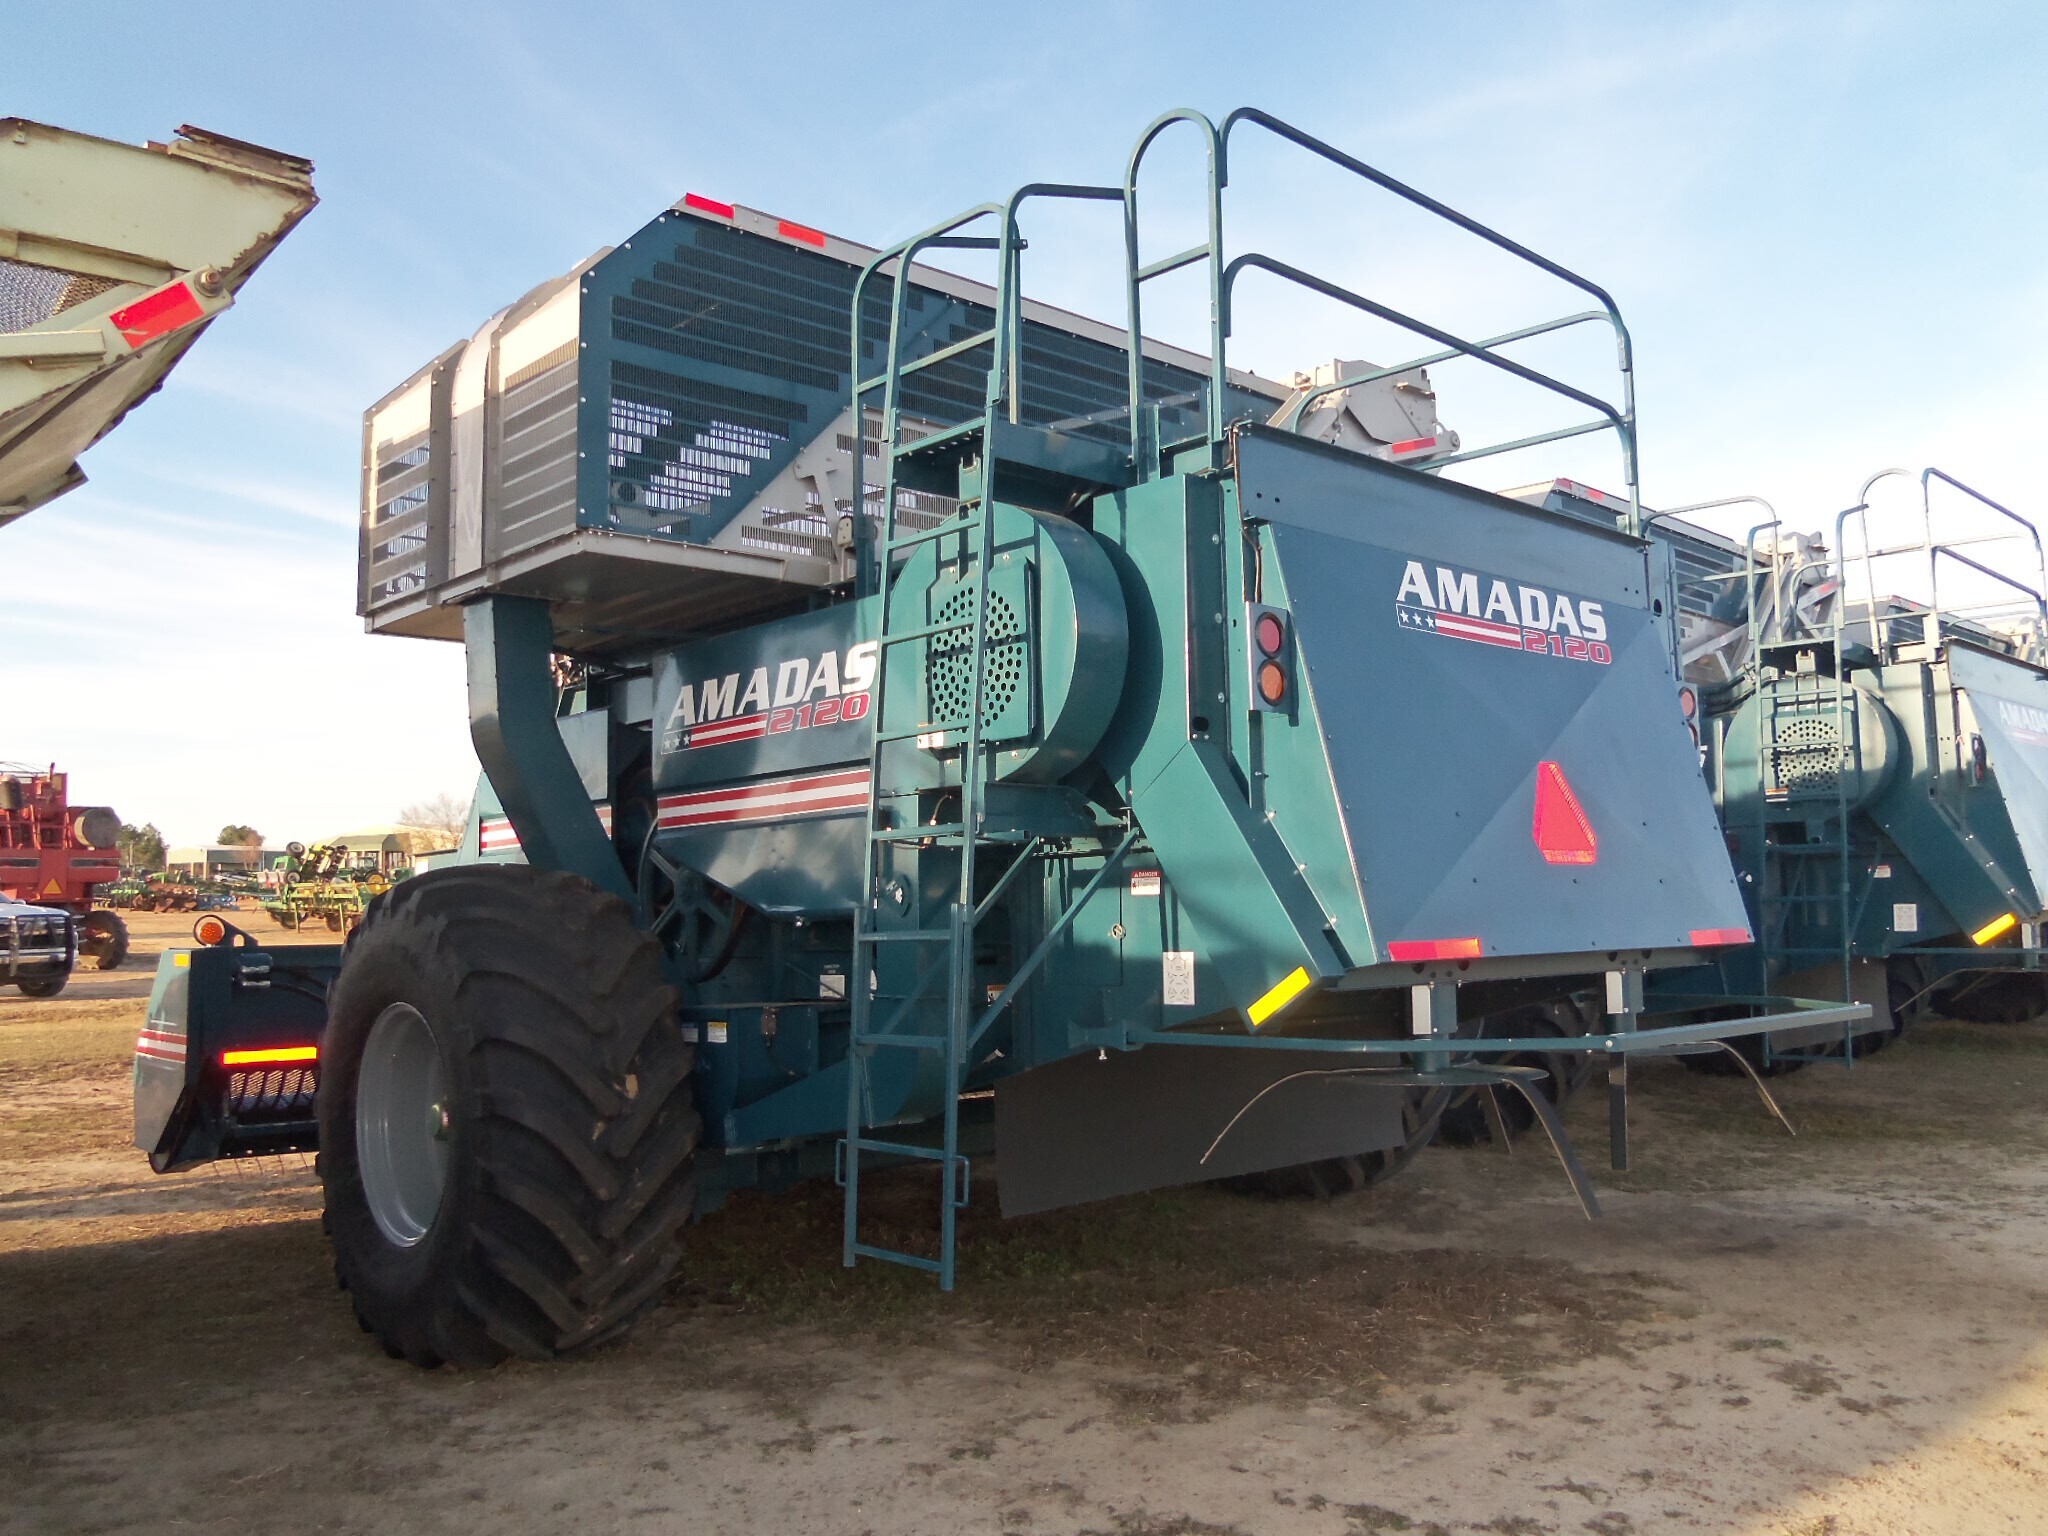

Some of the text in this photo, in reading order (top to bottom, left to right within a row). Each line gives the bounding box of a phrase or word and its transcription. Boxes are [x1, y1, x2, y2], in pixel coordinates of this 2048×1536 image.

[1396, 560, 1607, 641] AMADAS
[1523, 629, 1612, 665] 2120
[664, 641, 878, 729] AMADAS
[767, 692, 871, 735] 2120
